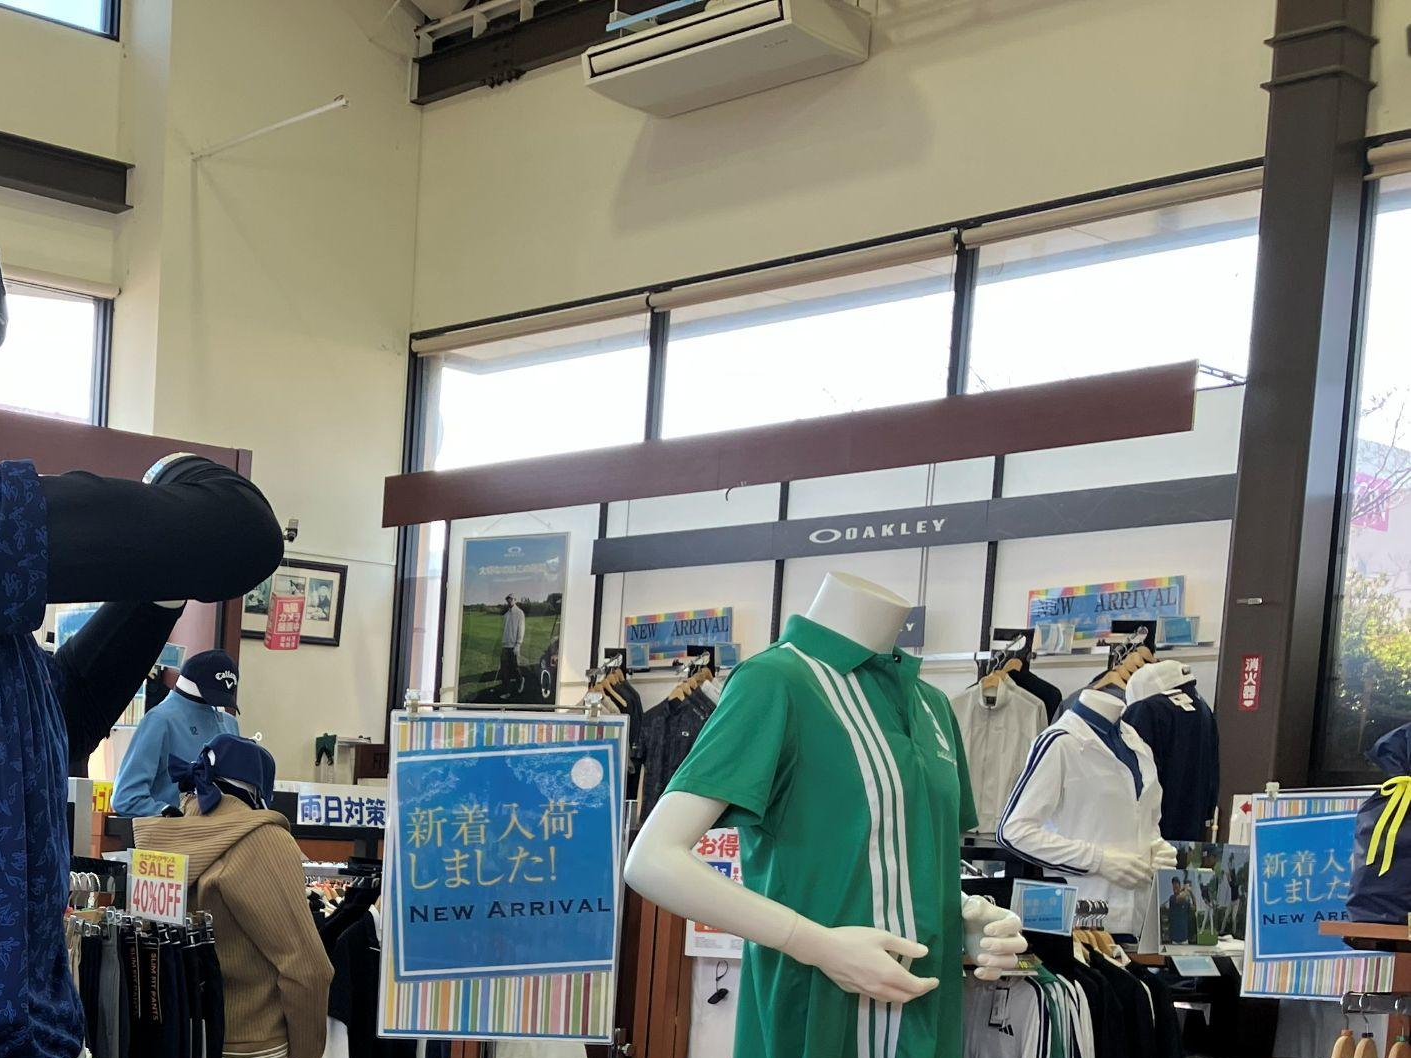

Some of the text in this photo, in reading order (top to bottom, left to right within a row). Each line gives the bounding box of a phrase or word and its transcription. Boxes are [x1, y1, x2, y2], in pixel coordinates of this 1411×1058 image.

[845, 519, 946, 540] OAKLEY
[1036, 587, 1177, 617] NEW ARRIVAL
[630, 616, 729, 640] NEW ARRIVAL
[1242, 657, 1259, 700] 消火器
[300, 793, 386, 827] 雨日対策
[406, 799, 580, 849] 新着入荷
[138, 860, 175, 879] SALE
[409, 845, 558, 890] しました!
[132, 878, 182, 918] 40%OFF
